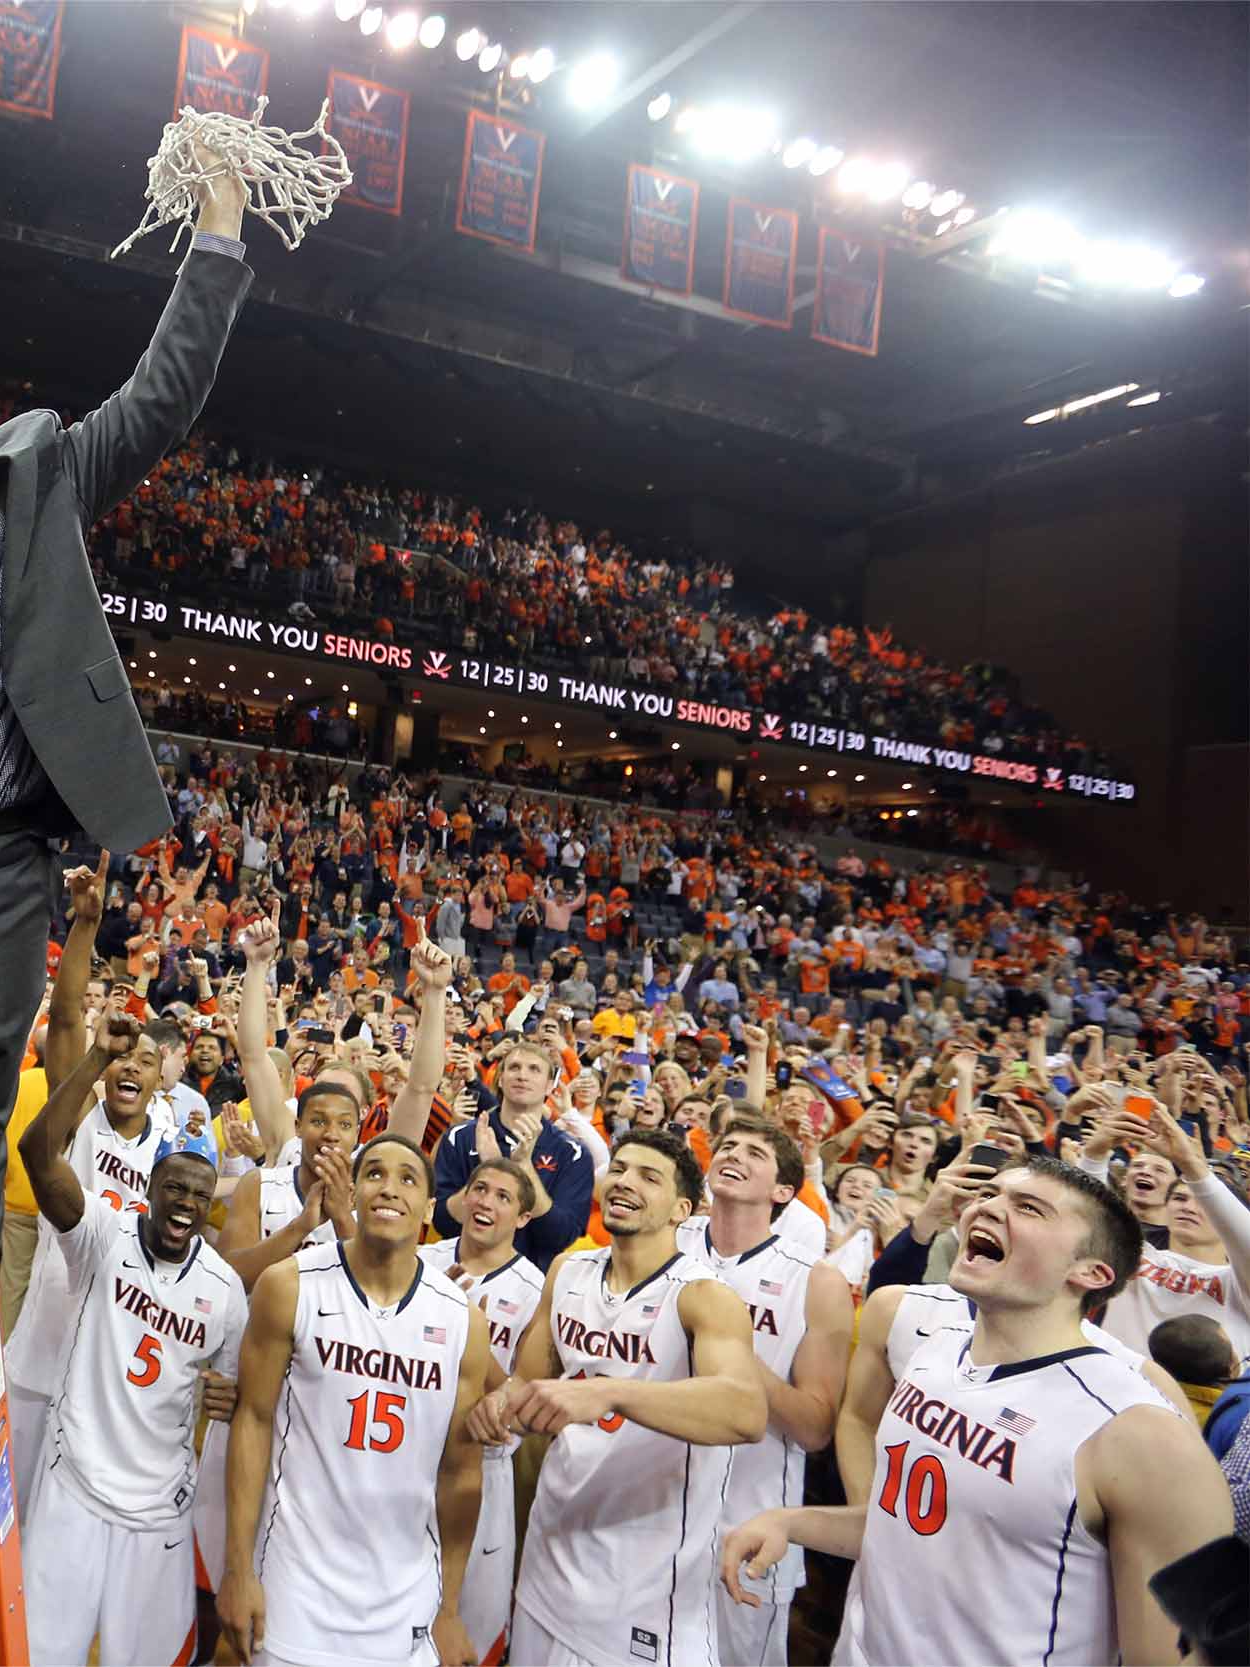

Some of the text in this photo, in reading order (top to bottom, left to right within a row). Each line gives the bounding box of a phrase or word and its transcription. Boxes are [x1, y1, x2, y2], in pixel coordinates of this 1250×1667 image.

[180, 607, 263, 642] THANK
[268, 623, 318, 651] YOU
[323, 634, 412, 669] SENIORS
[558, 676, 626, 709] THANK
[631, 691, 673, 717] YOU
[677, 699, 751, 732] SENIORS
[872, 736, 931, 765] THANK
[932, 748, 971, 771] YOU
[972, 755, 1038, 783] SENIORS
[114, 1276, 207, 1349] VIRGINIA
[126, 1333, 164, 1387] 5
[314, 1336, 442, 1391] VIRGINIA
[342, 1389, 407, 1454] 15
[892, 1378, 1018, 1485] VIRGINIA
[878, 1440, 947, 1536] 10
